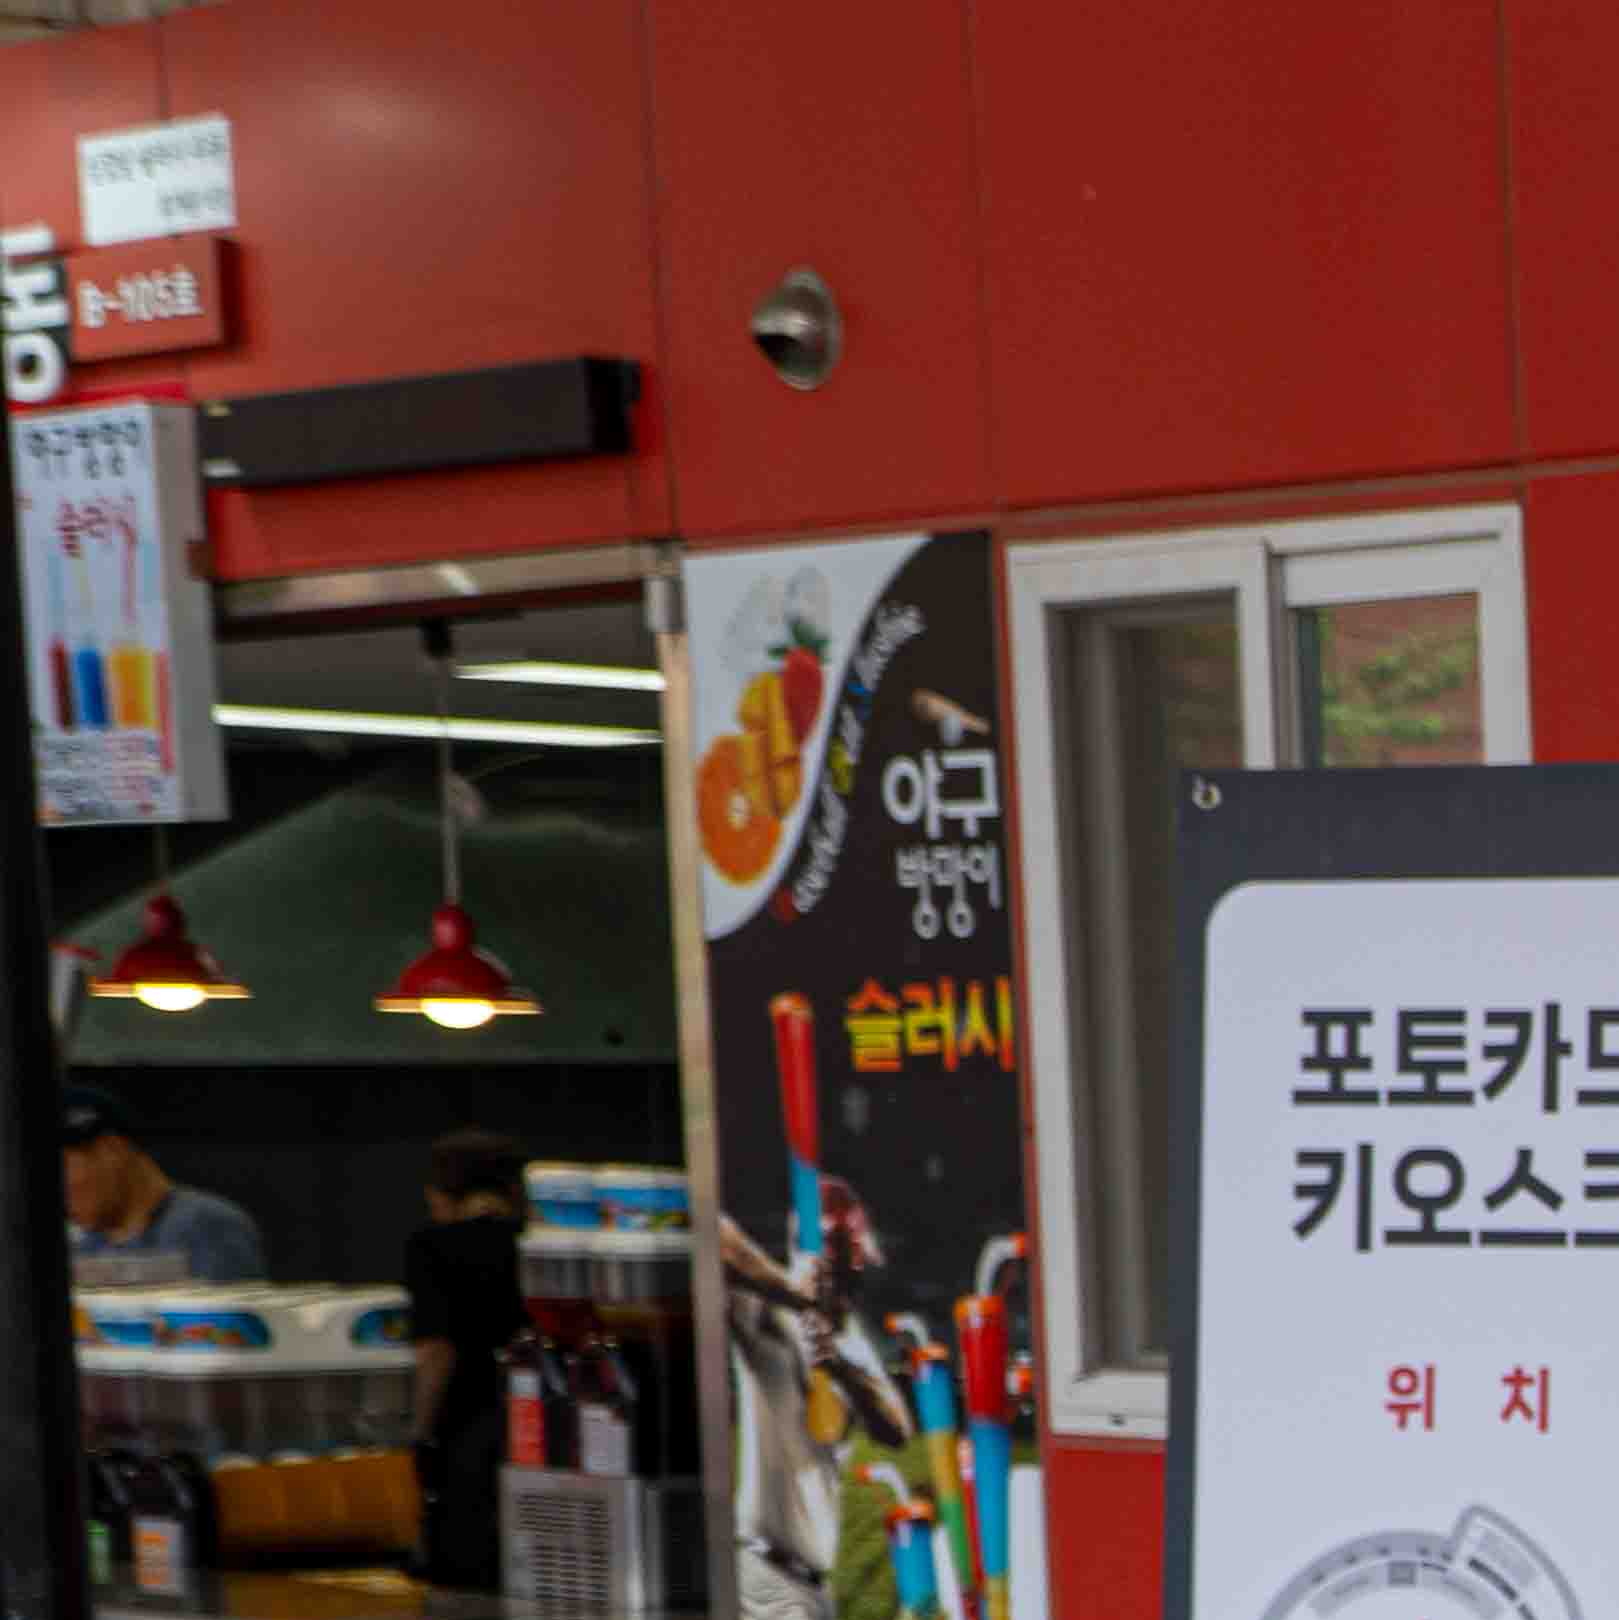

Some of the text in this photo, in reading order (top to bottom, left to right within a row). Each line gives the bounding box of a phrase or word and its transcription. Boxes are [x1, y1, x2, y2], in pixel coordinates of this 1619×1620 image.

[881, 748, 1000, 838] 야구
[896, 840, 1001, 940] 방망이
[845, 977, 1015, 1072] 슬러시
